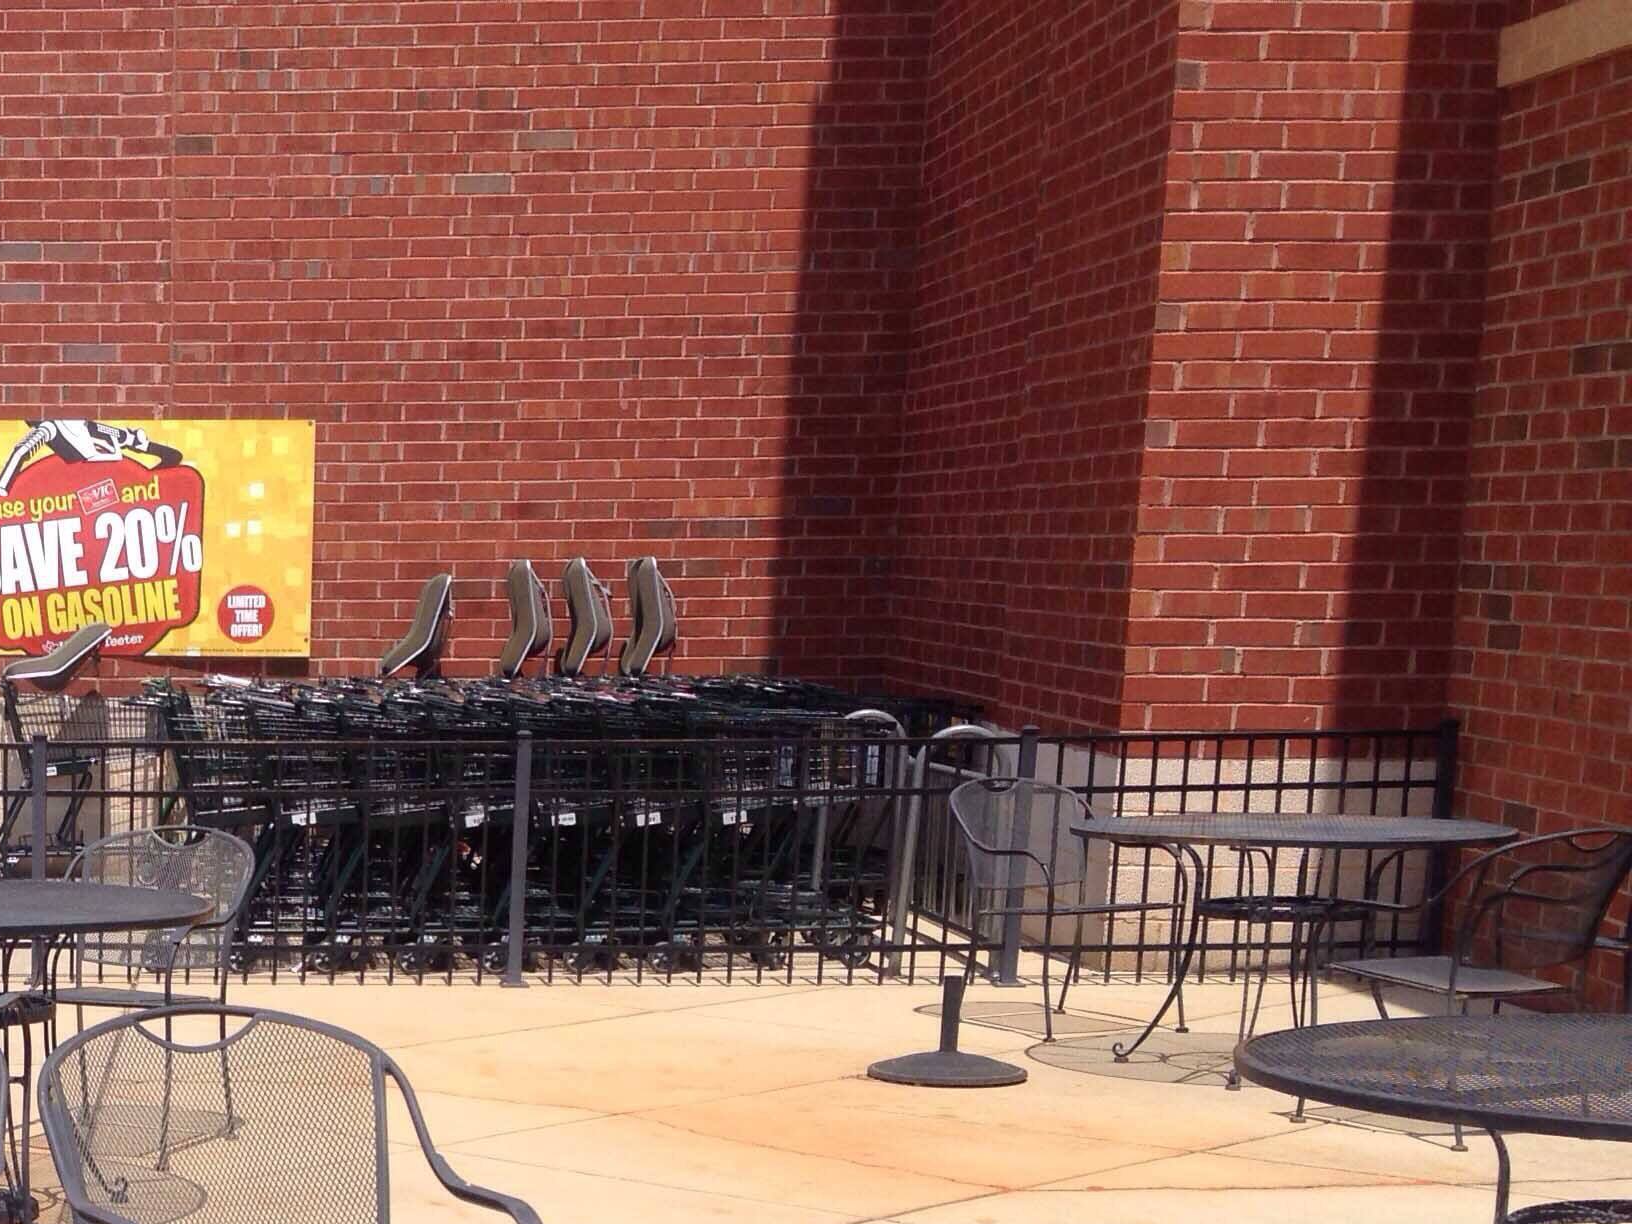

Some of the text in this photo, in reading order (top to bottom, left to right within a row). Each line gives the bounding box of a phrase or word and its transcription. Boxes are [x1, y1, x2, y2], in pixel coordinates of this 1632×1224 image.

[29, 493, 76, 521] your
[121, 475, 160, 503] and
[94, 502, 202, 583] 20%
[2, 579, 182, 640] ON GASOLINE
[227, 595, 266, 608] LIMITED
[234, 609, 259, 623] TIME
[230, 623, 263, 637] OFFER!
